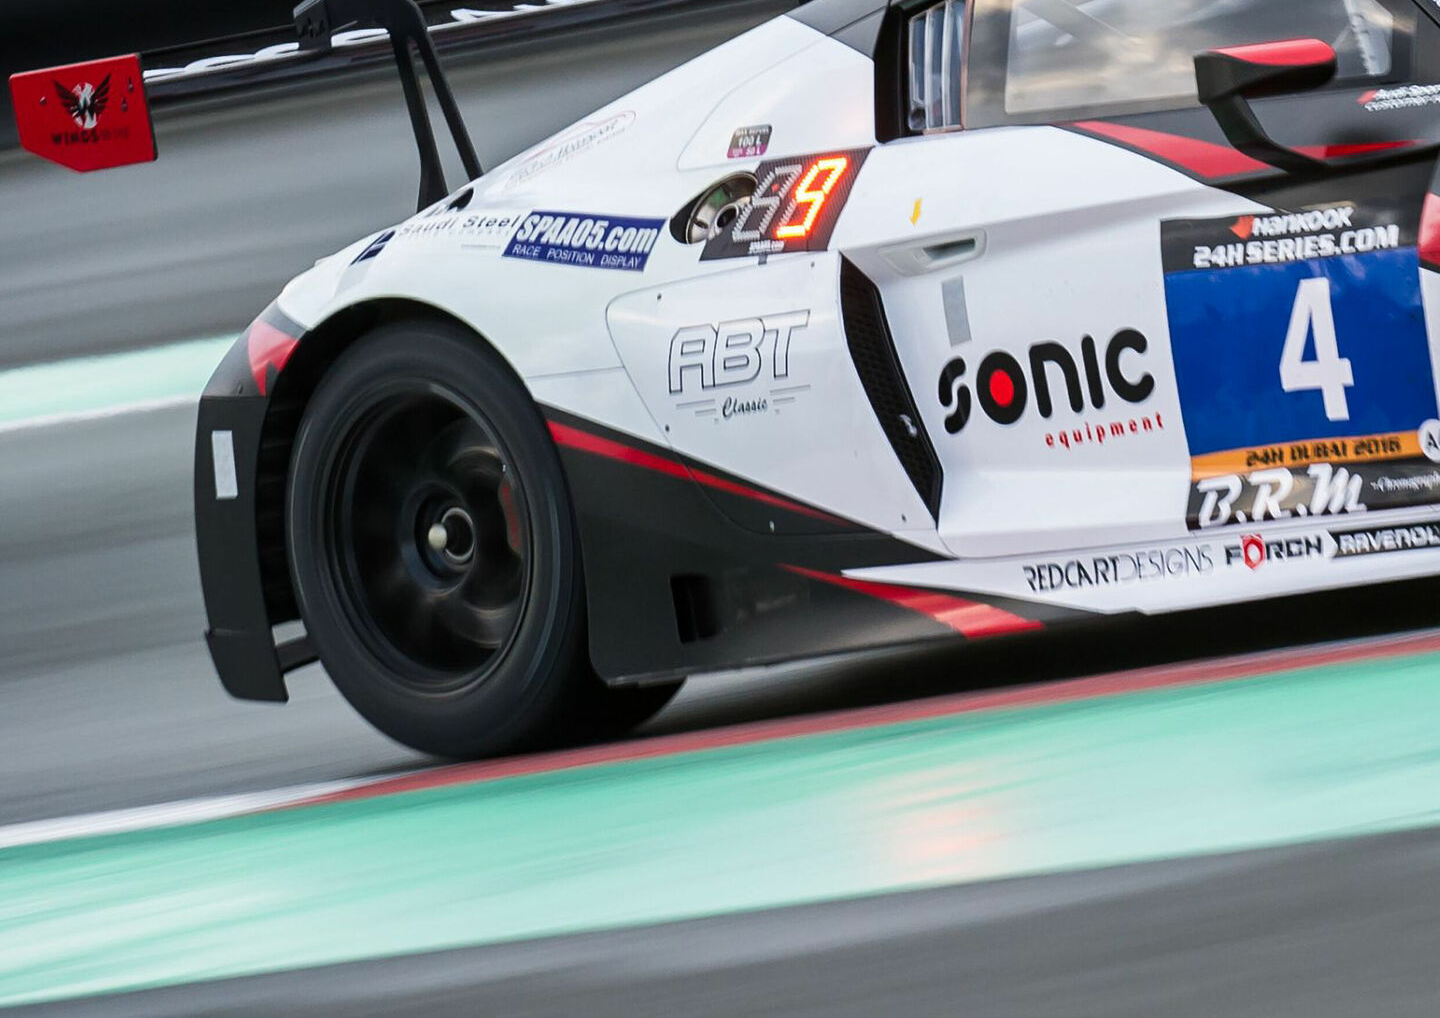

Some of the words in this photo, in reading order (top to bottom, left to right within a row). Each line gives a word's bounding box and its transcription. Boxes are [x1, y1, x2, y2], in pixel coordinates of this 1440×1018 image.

[462, 214, 521, 229] Steel
[511, 242, 542, 257] RACE
[546, 246, 596, 266] POSITION
[599, 253, 643, 270] DISPLAY
[668, 308, 812, 395] ABT
[1279, 276, 1355, 422] 4
[721, 395, 770, 420] Classic
[1045, 411, 1166, 452] equipment
